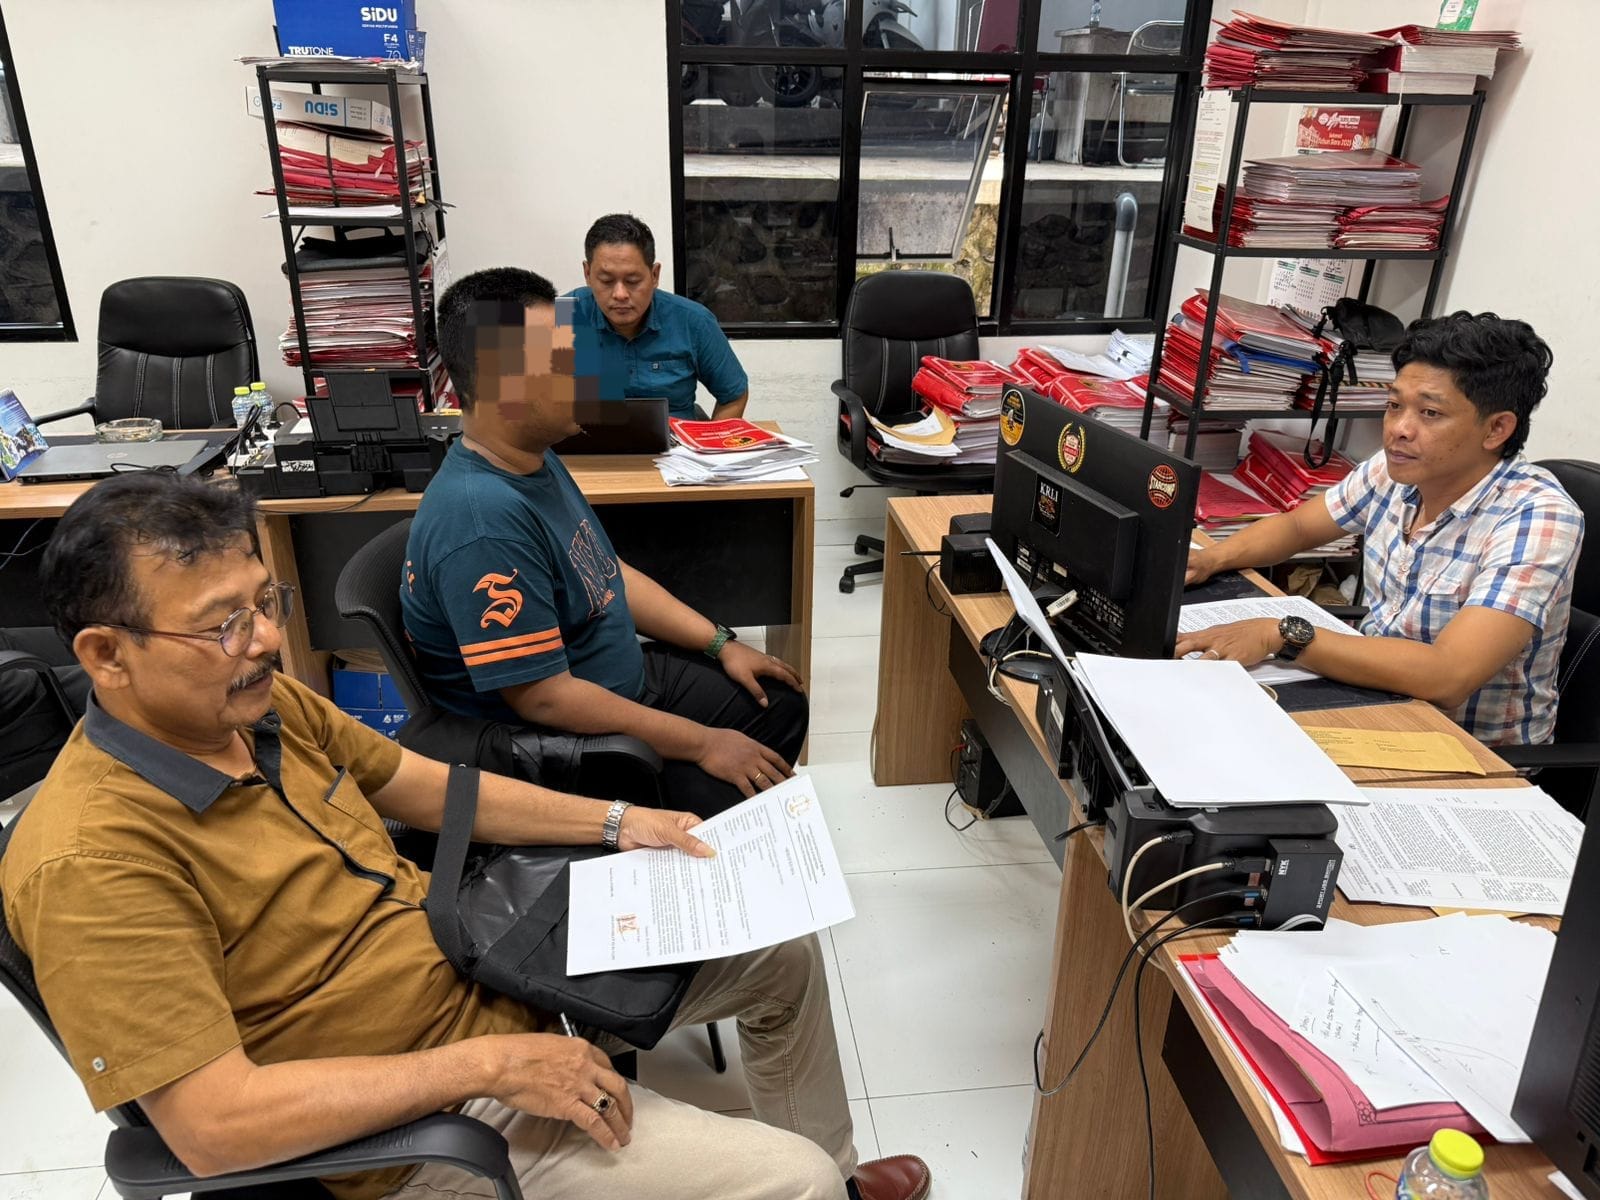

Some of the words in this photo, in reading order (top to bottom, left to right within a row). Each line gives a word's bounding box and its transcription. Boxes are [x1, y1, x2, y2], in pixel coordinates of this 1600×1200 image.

[361, 7, 397, 22] SiDU
[384, 33, 398, 43] F4
[288, 46, 335, 56] TRUTONE
[304, 100, 339, 117] SiDU
[1278, 859, 1289, 875] NYK
